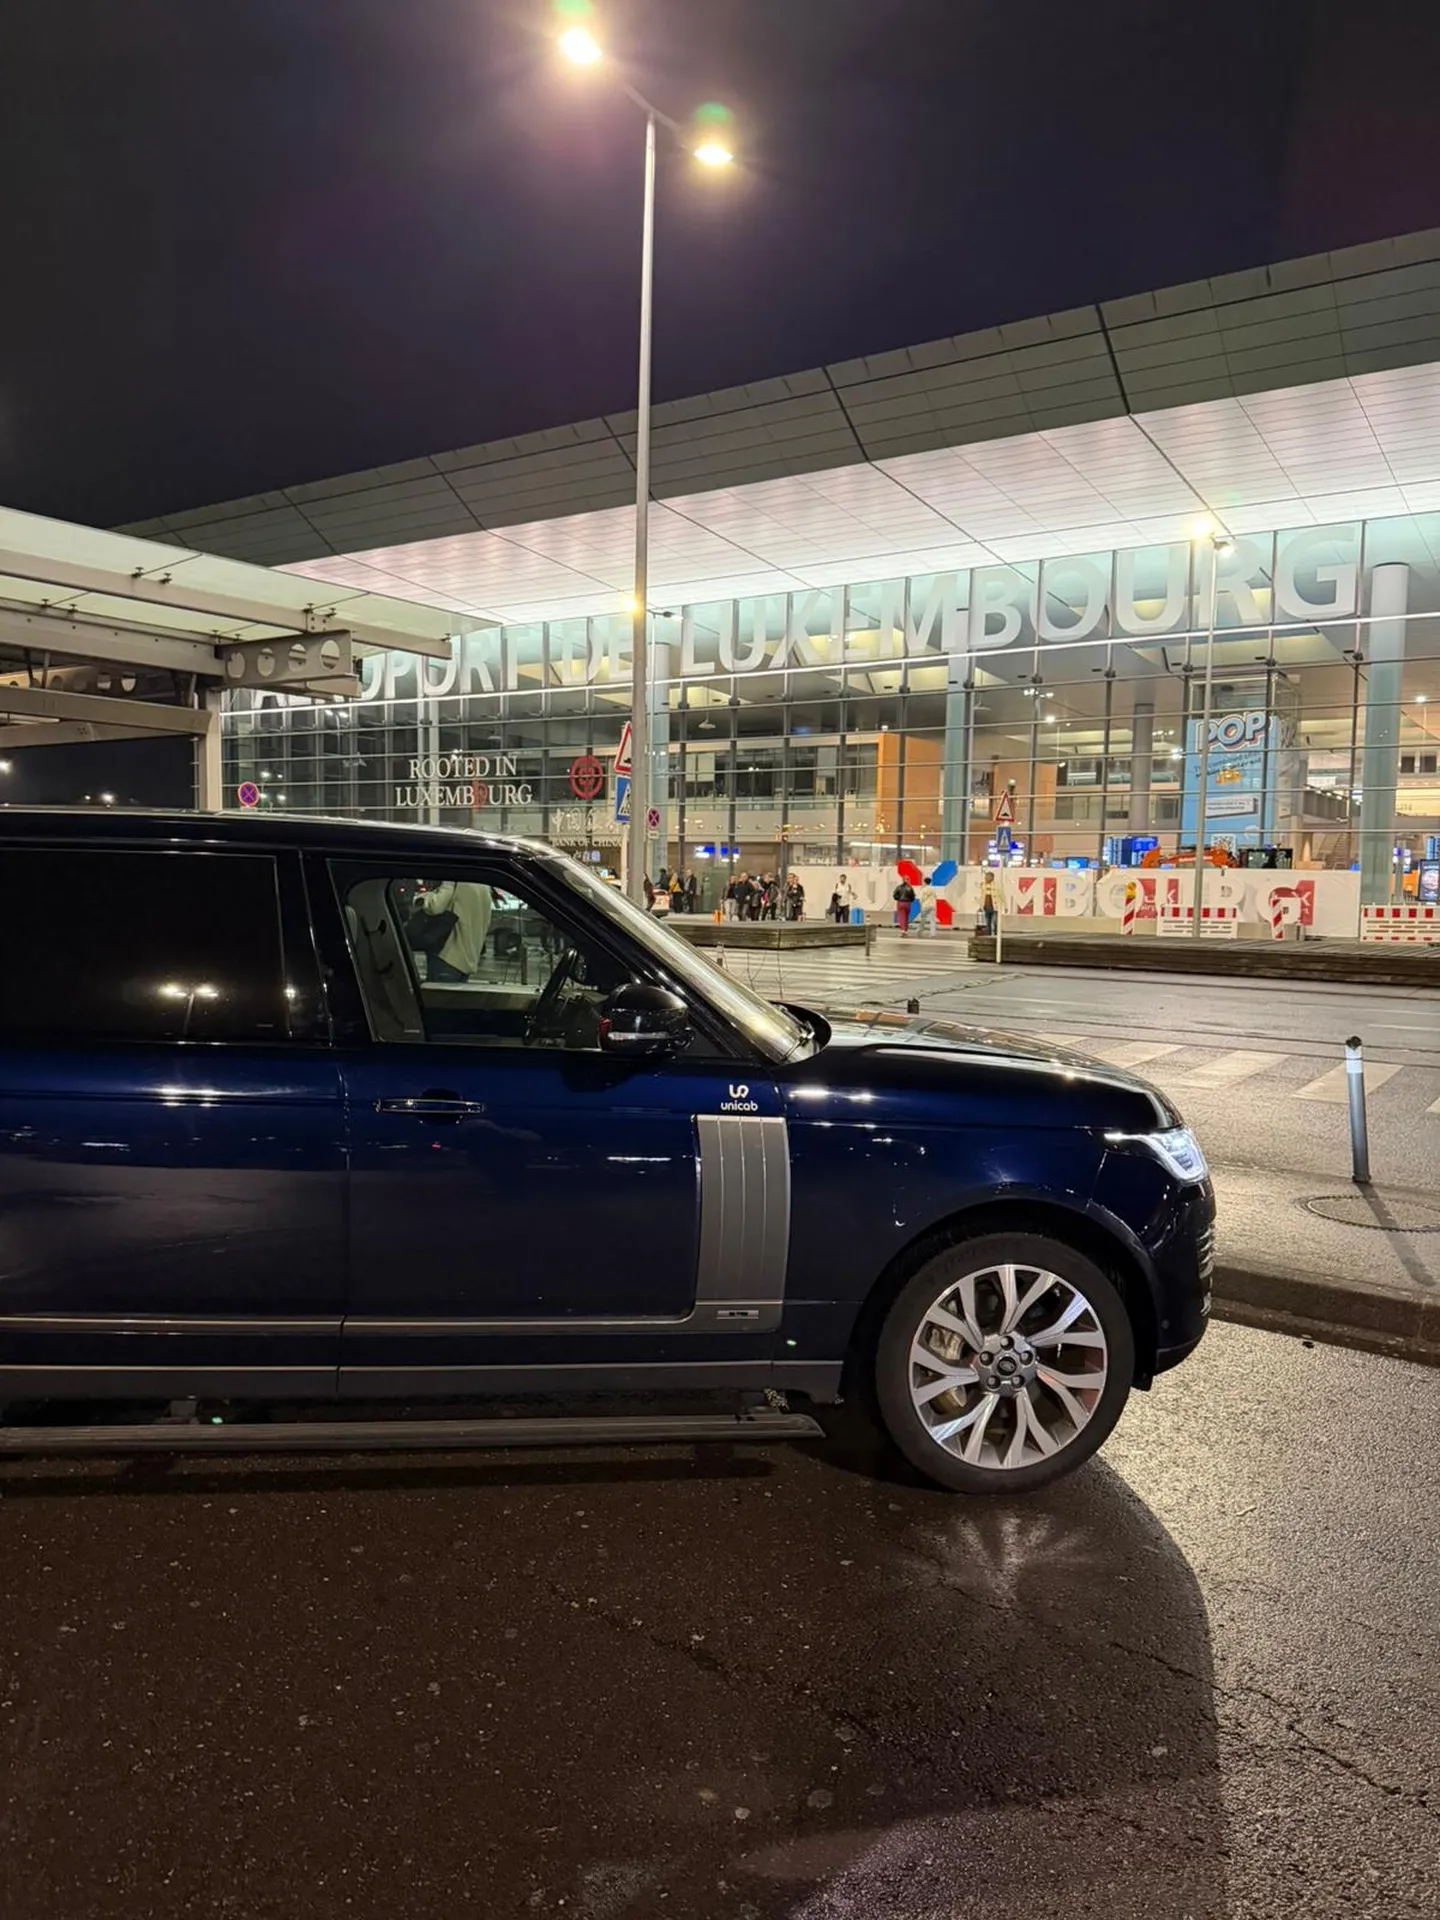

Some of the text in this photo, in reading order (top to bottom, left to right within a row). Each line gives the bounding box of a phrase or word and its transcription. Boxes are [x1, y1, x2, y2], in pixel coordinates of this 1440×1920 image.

[252, 620, 532, 706] OPORT
[681, 526, 1358, 677] LUXEMBOURG
[1195, 711, 1271, 752] POP
[409, 755, 518, 779] ROOTED IN
[551, 838, 576, 848] BANK
[578, 838, 591, 848] OF
[720, 1100, 759, 1111] unicab
